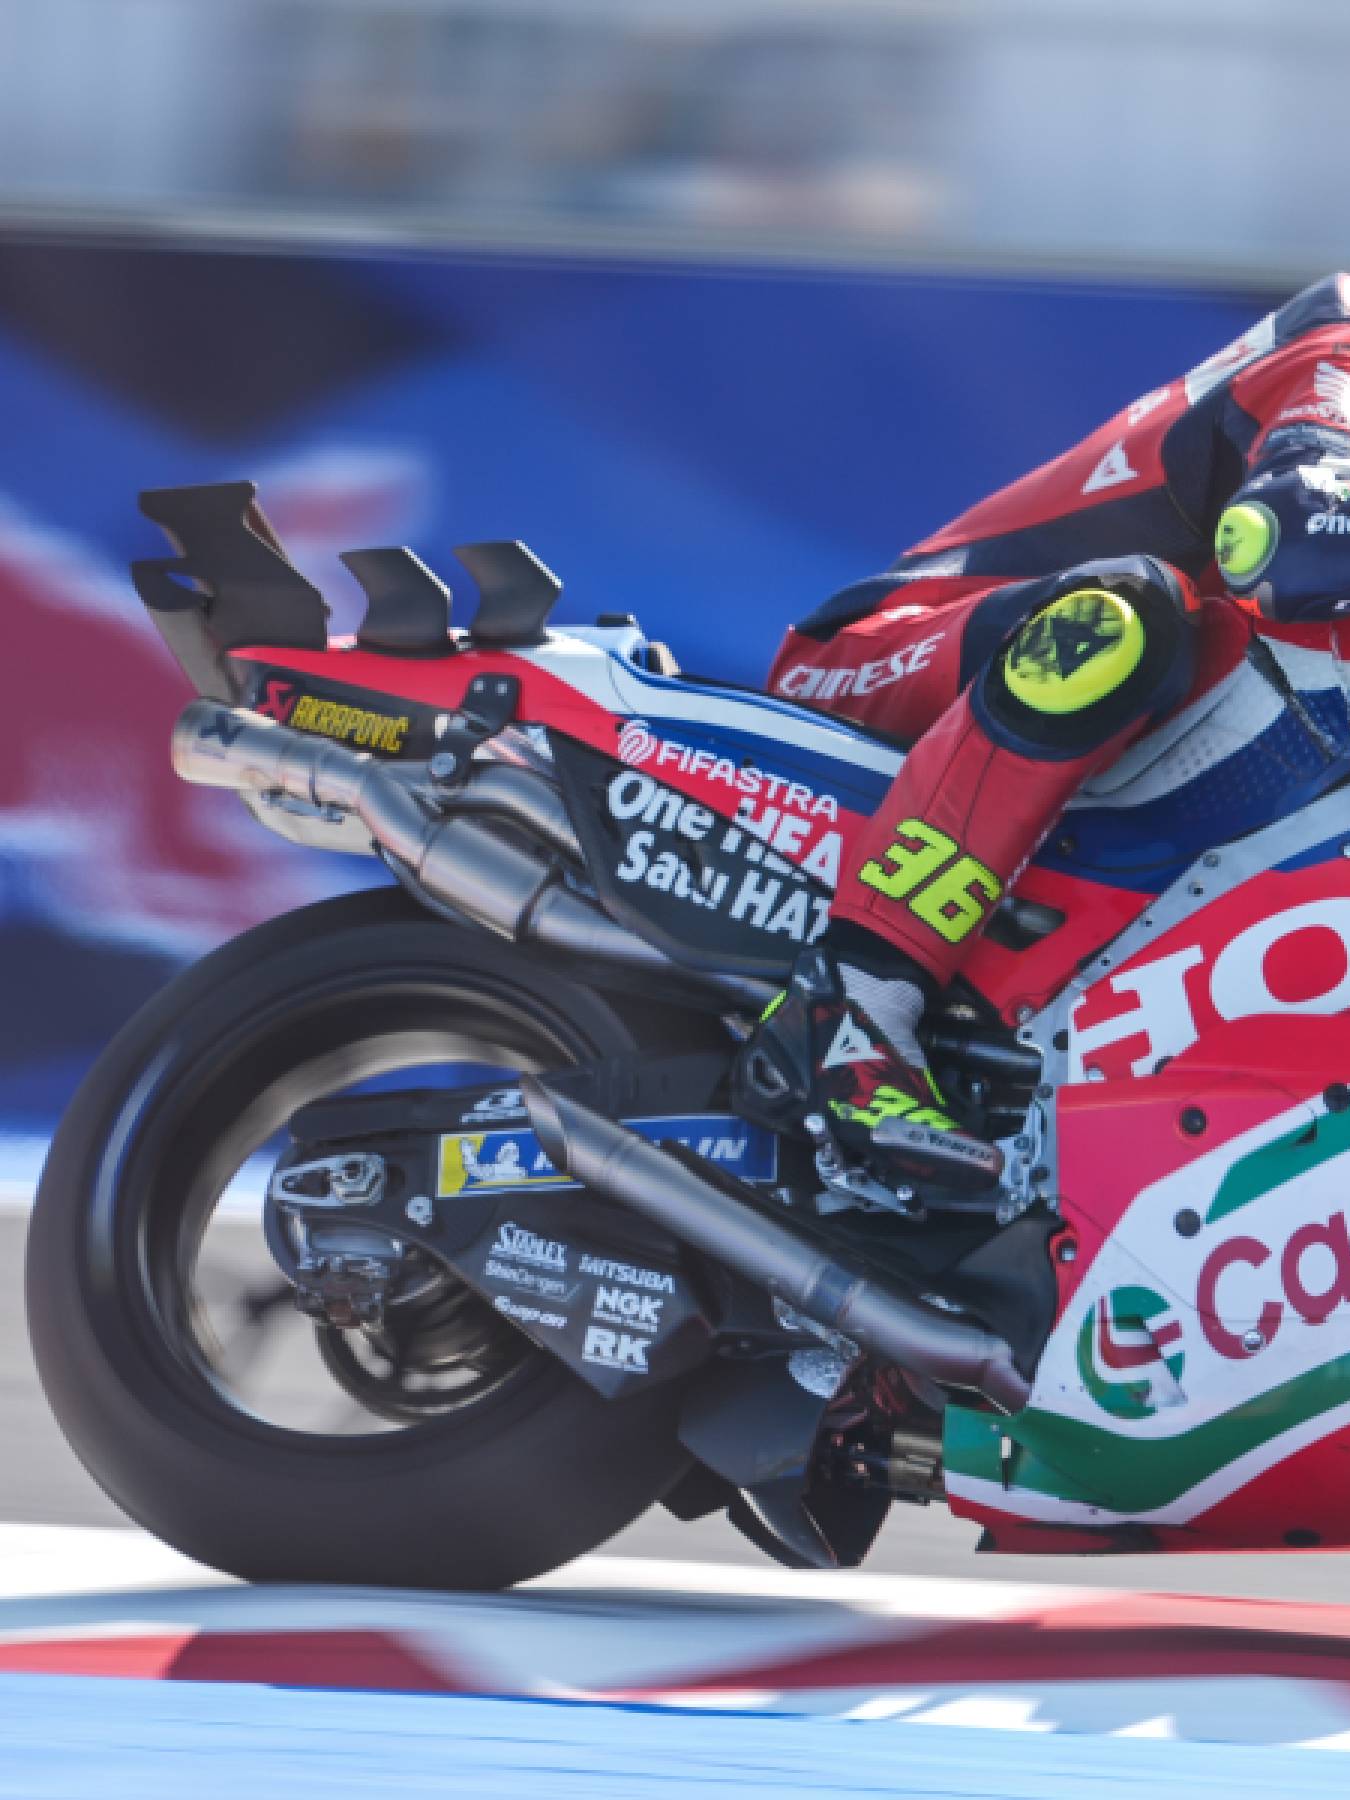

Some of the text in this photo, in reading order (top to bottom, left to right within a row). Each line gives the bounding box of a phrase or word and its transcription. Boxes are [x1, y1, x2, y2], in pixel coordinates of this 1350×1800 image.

[607, 771, 714, 840] One
[656, 740, 838, 823] FIFASTRA
[858, 818, 1003, 943] 36
[579, 1254, 676, 1294] MITSUBA
[596, 1286, 664, 1323] NGK
[584, 1326, 652, 1364] RK
